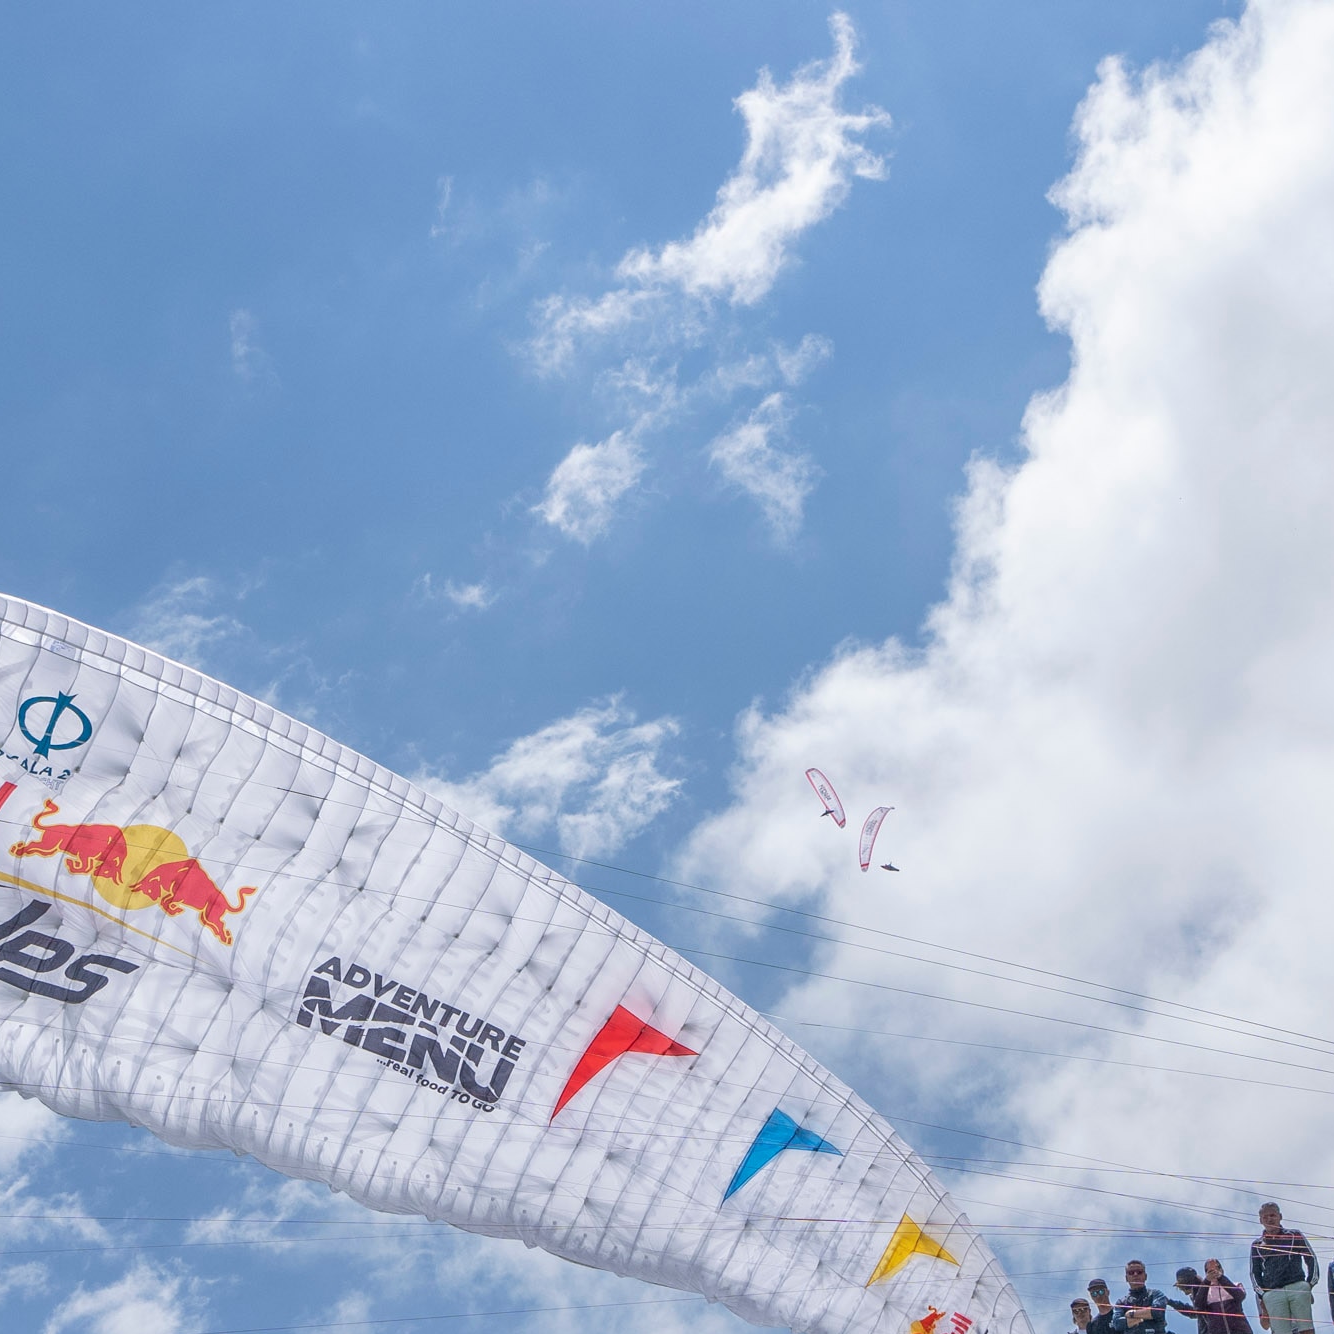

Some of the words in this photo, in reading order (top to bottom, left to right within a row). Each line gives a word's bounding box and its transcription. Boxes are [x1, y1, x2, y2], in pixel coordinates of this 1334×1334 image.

[296, 975, 515, 1104] MENU
[313, 956, 526, 1062] ADVENTURE
[415, 1074, 449, 1095] food
[450, 1089, 471, 1104] TO
[471, 1099, 495, 1113] GO
